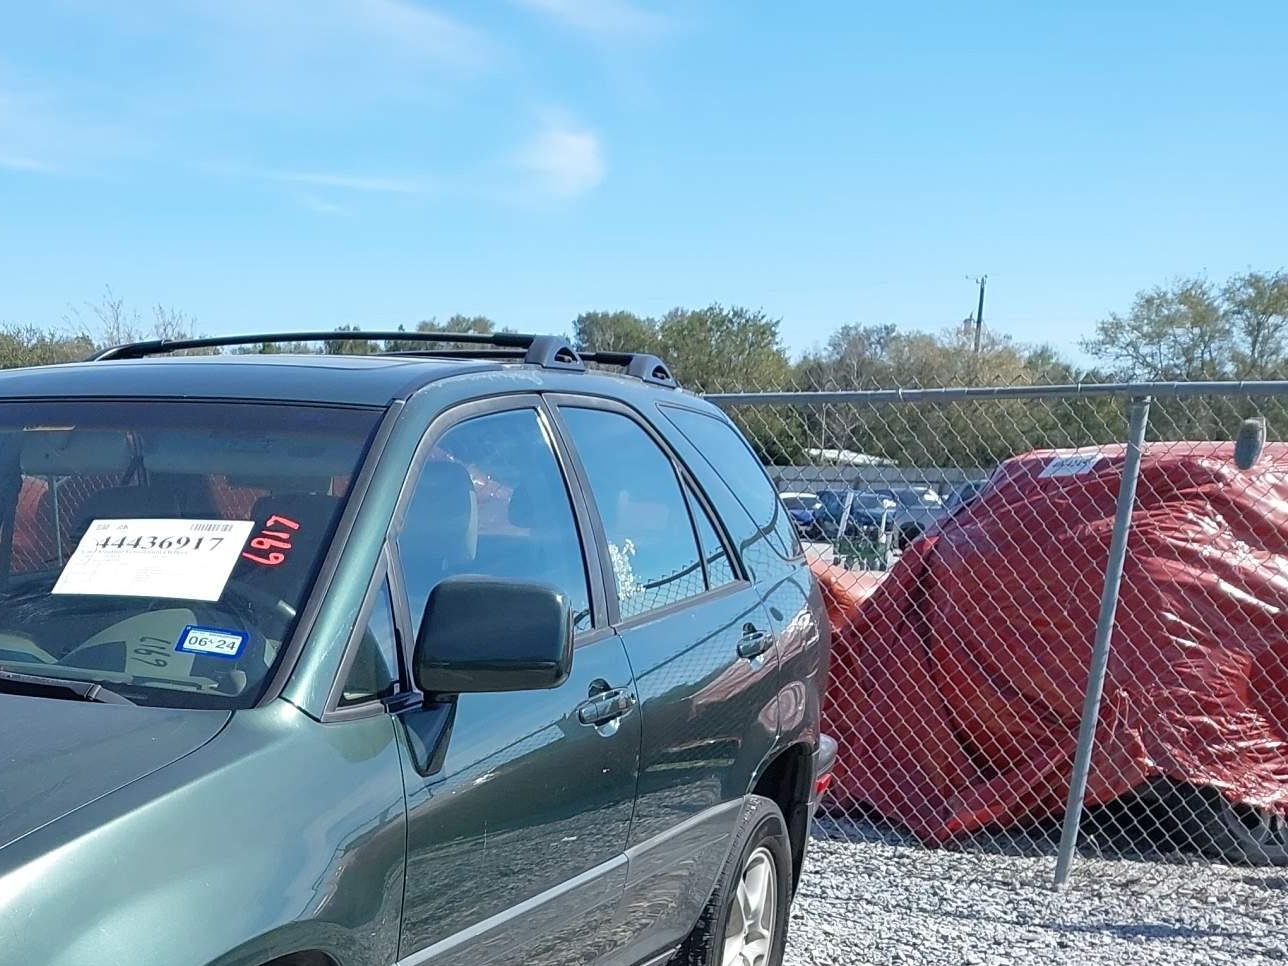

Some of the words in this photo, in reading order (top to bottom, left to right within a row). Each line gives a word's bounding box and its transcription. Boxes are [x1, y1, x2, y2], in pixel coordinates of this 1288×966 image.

[97, 536, 224, 551] 44436917
[243, 515, 301, 566] 6917
[188, 635, 209, 647] 06
[215, 639, 237, 651] 24
